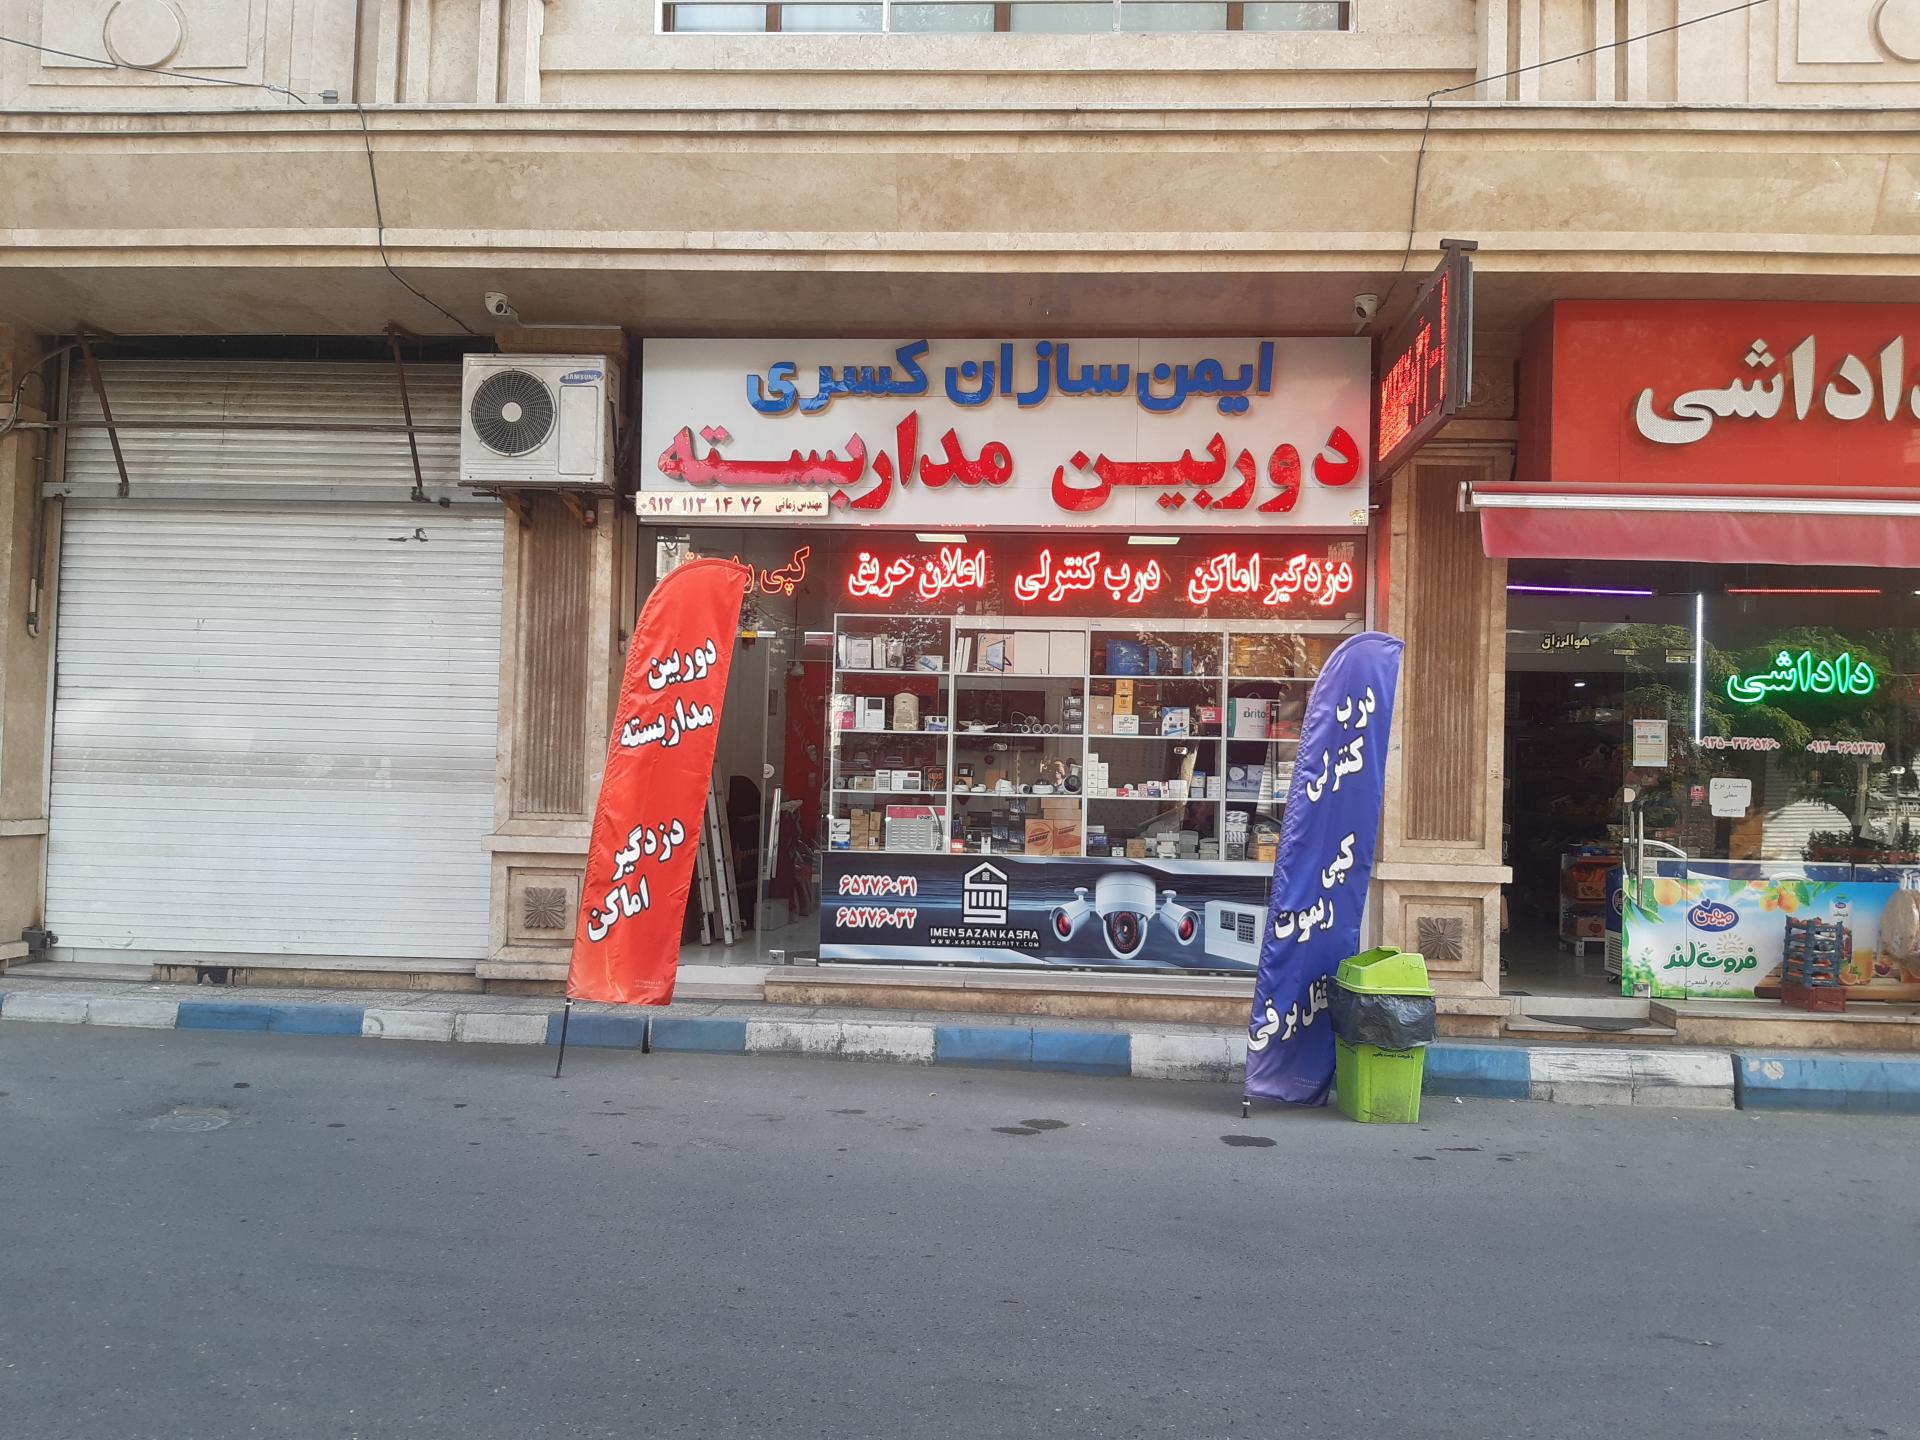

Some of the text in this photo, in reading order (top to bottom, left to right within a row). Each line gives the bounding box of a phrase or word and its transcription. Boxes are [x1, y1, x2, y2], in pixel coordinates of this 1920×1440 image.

[747, 340, 1274, 414] ایمن سازان کسری
[1636, 335, 1920, 444] اداشی
[658, 409, 1360, 514] دوربین مداربسته
[715, 496, 733, 512] ۱۴
[741, 496, 762, 512] ۷۶
[775, 497, 797, 512] زمانی
[797, 499, 823, 512] مهندس
[760, 545, 810, 596] کپی
[849, 547, 985, 598] اعلان حریق
[1014, 549, 1160, 603] درب کنترلی
[1188, 552, 1352, 605] دزدگیر اماکن
[648, 638, 717, 691] دوربین
[1727, 650, 1875, 703] داداشی
[620, 697, 714, 748] مداربسته
[1336, 685, 1376, 731] درب
[1306, 735, 1364, 802] کنترلی
[611, 818, 685, 882] دزدگیر
[1321, 832, 1355, 889] کپی
[588, 874, 650, 942] اماکن
[930, 927, 1039, 940] IMEN SAZAN KASRA
[1274, 896, 1334, 943] ریموت
[1247, 973, 1329, 1052] قفل برقی
